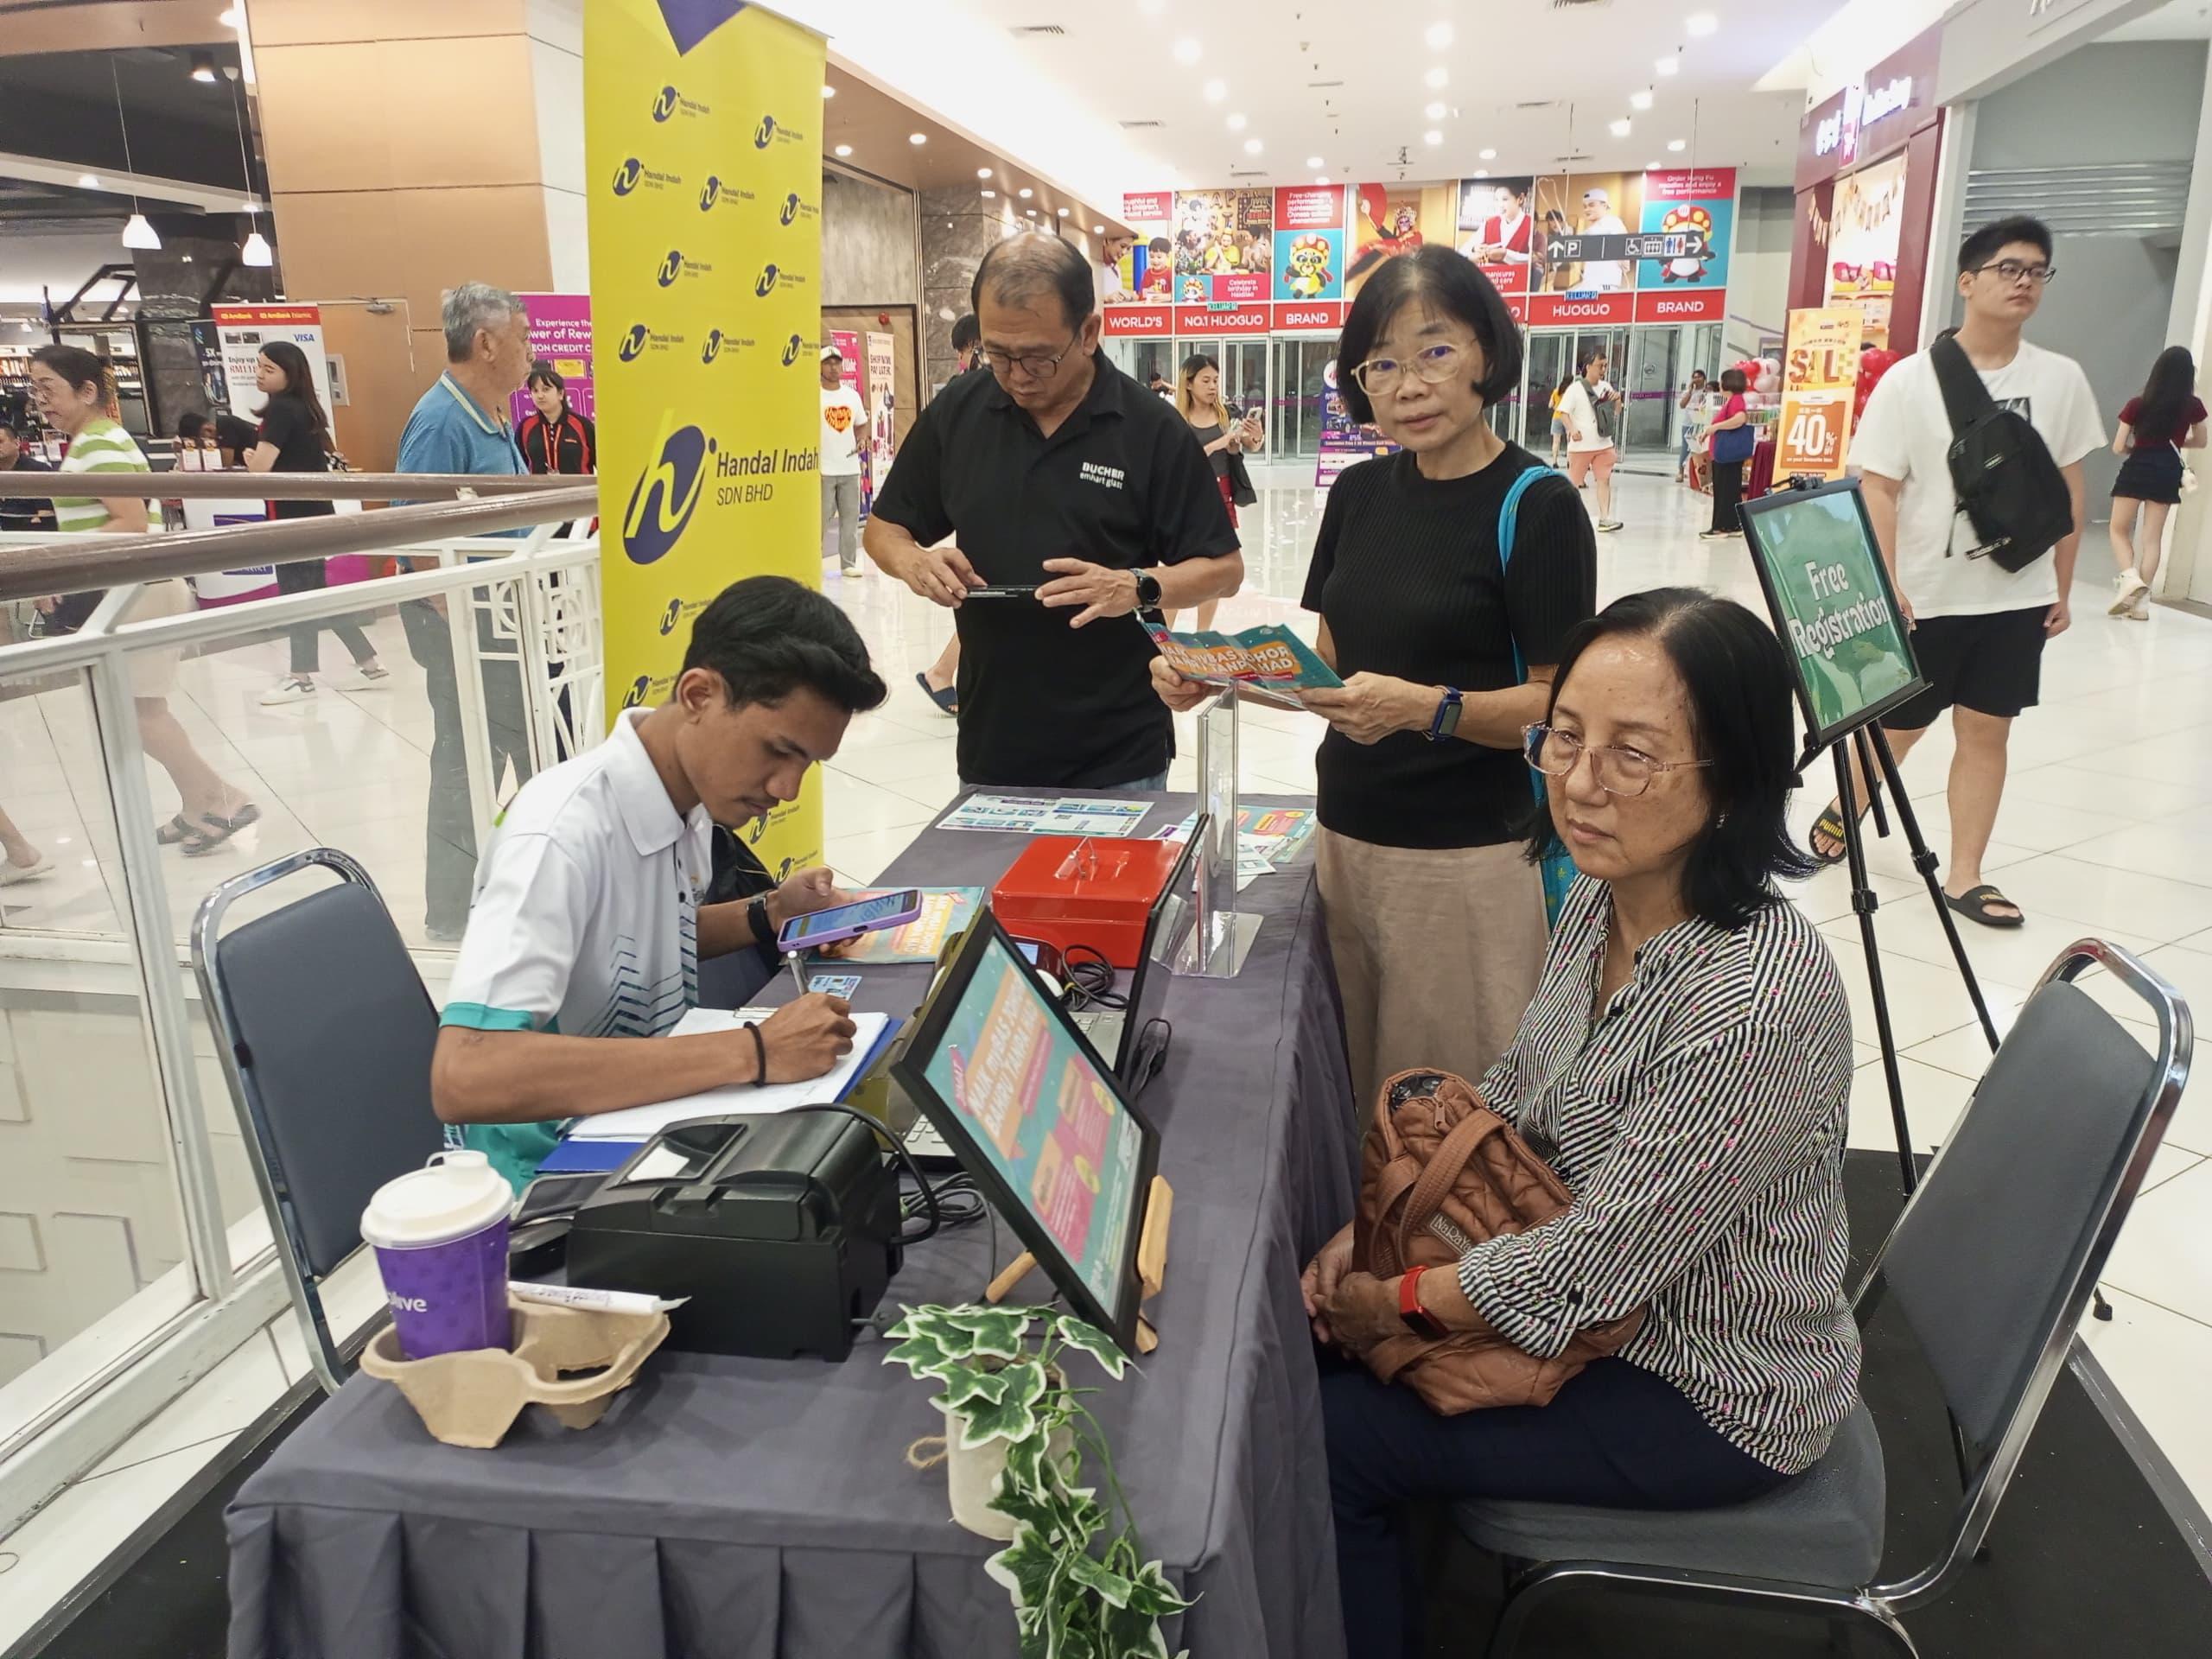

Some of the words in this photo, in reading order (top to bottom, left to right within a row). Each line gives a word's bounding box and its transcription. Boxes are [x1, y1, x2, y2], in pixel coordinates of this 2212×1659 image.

[1553, 303, 1611, 318] HUOGUO
[1656, 301, 1704, 315] BRAND
[536, 318, 580, 329] Experience
[1109, 316, 1163, 328] WORLD'S
[1211, 314, 1263, 327] HUOGUO
[1286, 313, 1329, 326] BRAND
[294, 334, 315, 342] VISA
[554, 328, 566, 340] of
[551, 343, 583, 353] CREDIT
[1789, 348, 1855, 384] SALE
[716, 449, 777, 478] Handal
[782, 446, 819, 473] Indah
[1082, 461, 1125, 480] BUCHER
[716, 486, 742, 506] SDN
[746, 484, 773, 504] BHD
[1804, 561, 1849, 601] Free
[1789, 592, 1891, 660] Registration
[1258, 658, 1294, 672] HAD
[966, 1064, 994, 1116] NAIK
